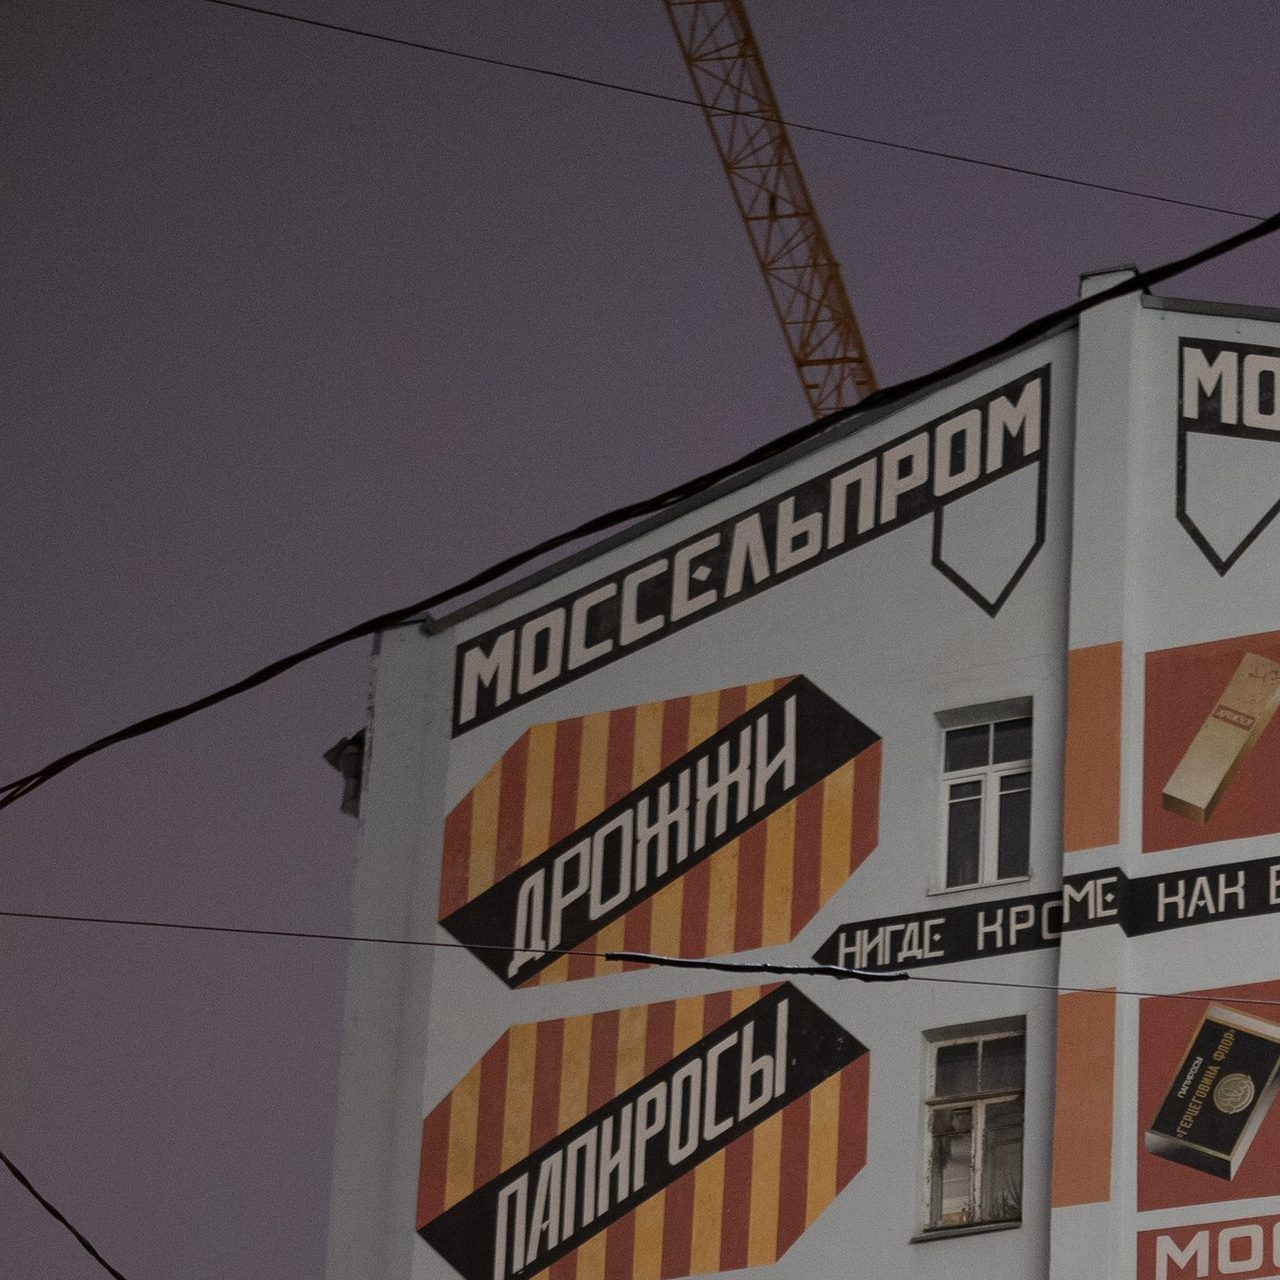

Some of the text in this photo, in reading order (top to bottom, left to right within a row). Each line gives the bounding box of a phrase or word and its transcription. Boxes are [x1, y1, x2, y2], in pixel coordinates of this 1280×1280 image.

[459, 378, 1042, 724] МОССЕЛЬПРОМ
[508, 694, 796, 979] ДРОЖЖИ
[838, 918, 945, 970] НИГДЕ
[977, 876, 1118, 951] КРОМЕ
[1157, 870, 1245, 921] КАК
